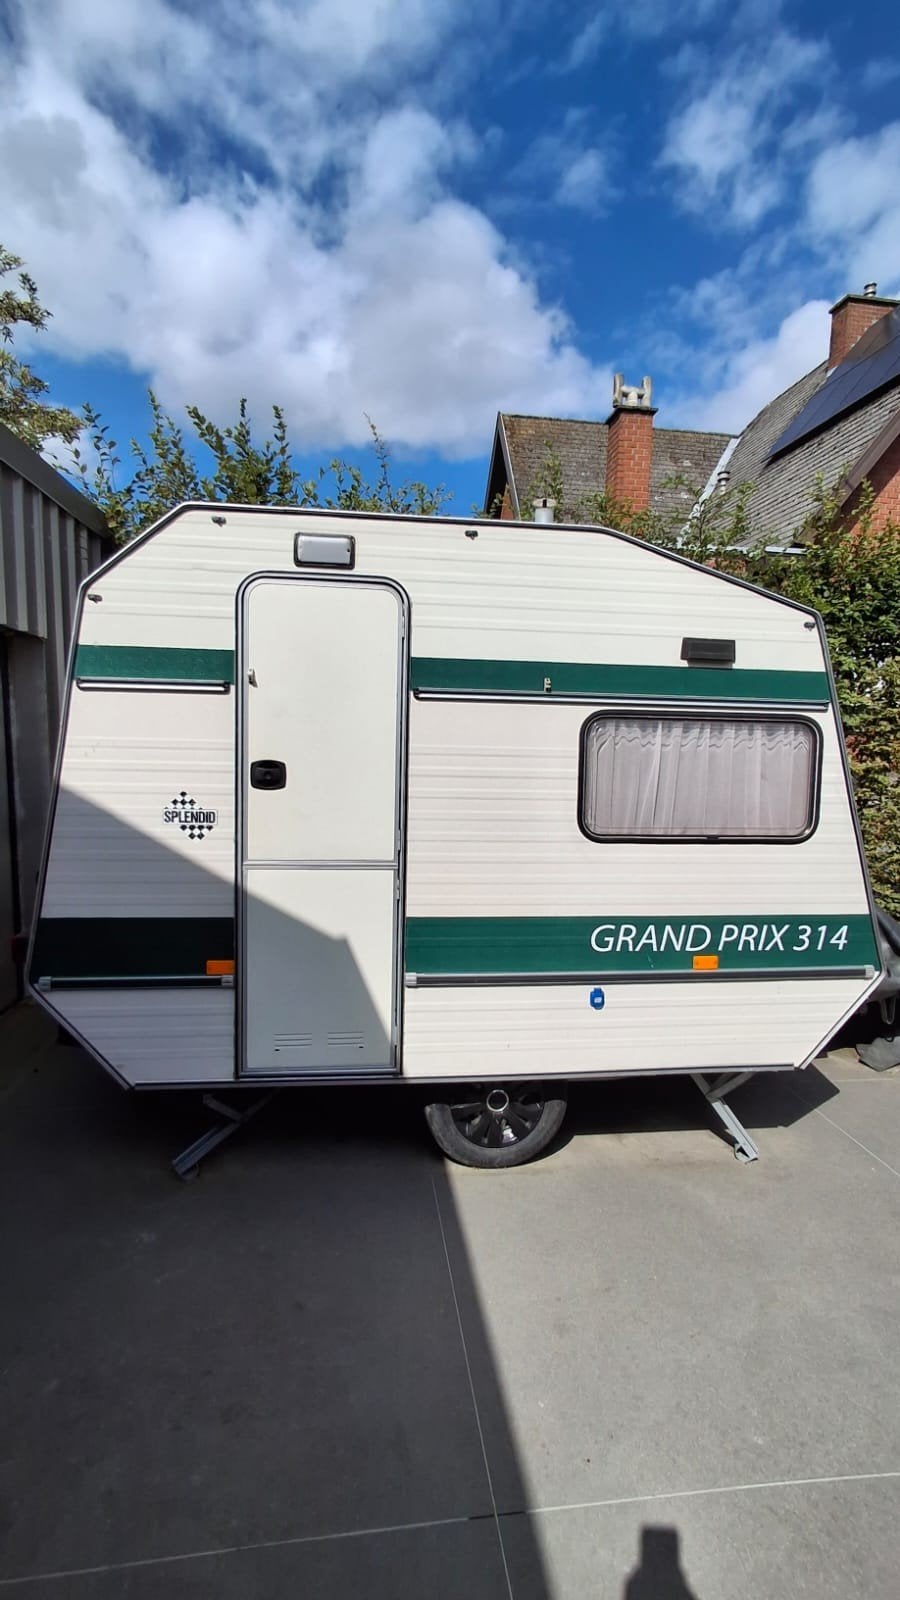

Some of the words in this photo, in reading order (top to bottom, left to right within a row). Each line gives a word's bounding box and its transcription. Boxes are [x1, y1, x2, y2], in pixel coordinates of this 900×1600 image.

[164, 811, 216, 823] SPLENDID
[590, 924, 712, 951] GRAND
[718, 924, 790, 951] PRIX
[792, 924, 848, 951] 314
